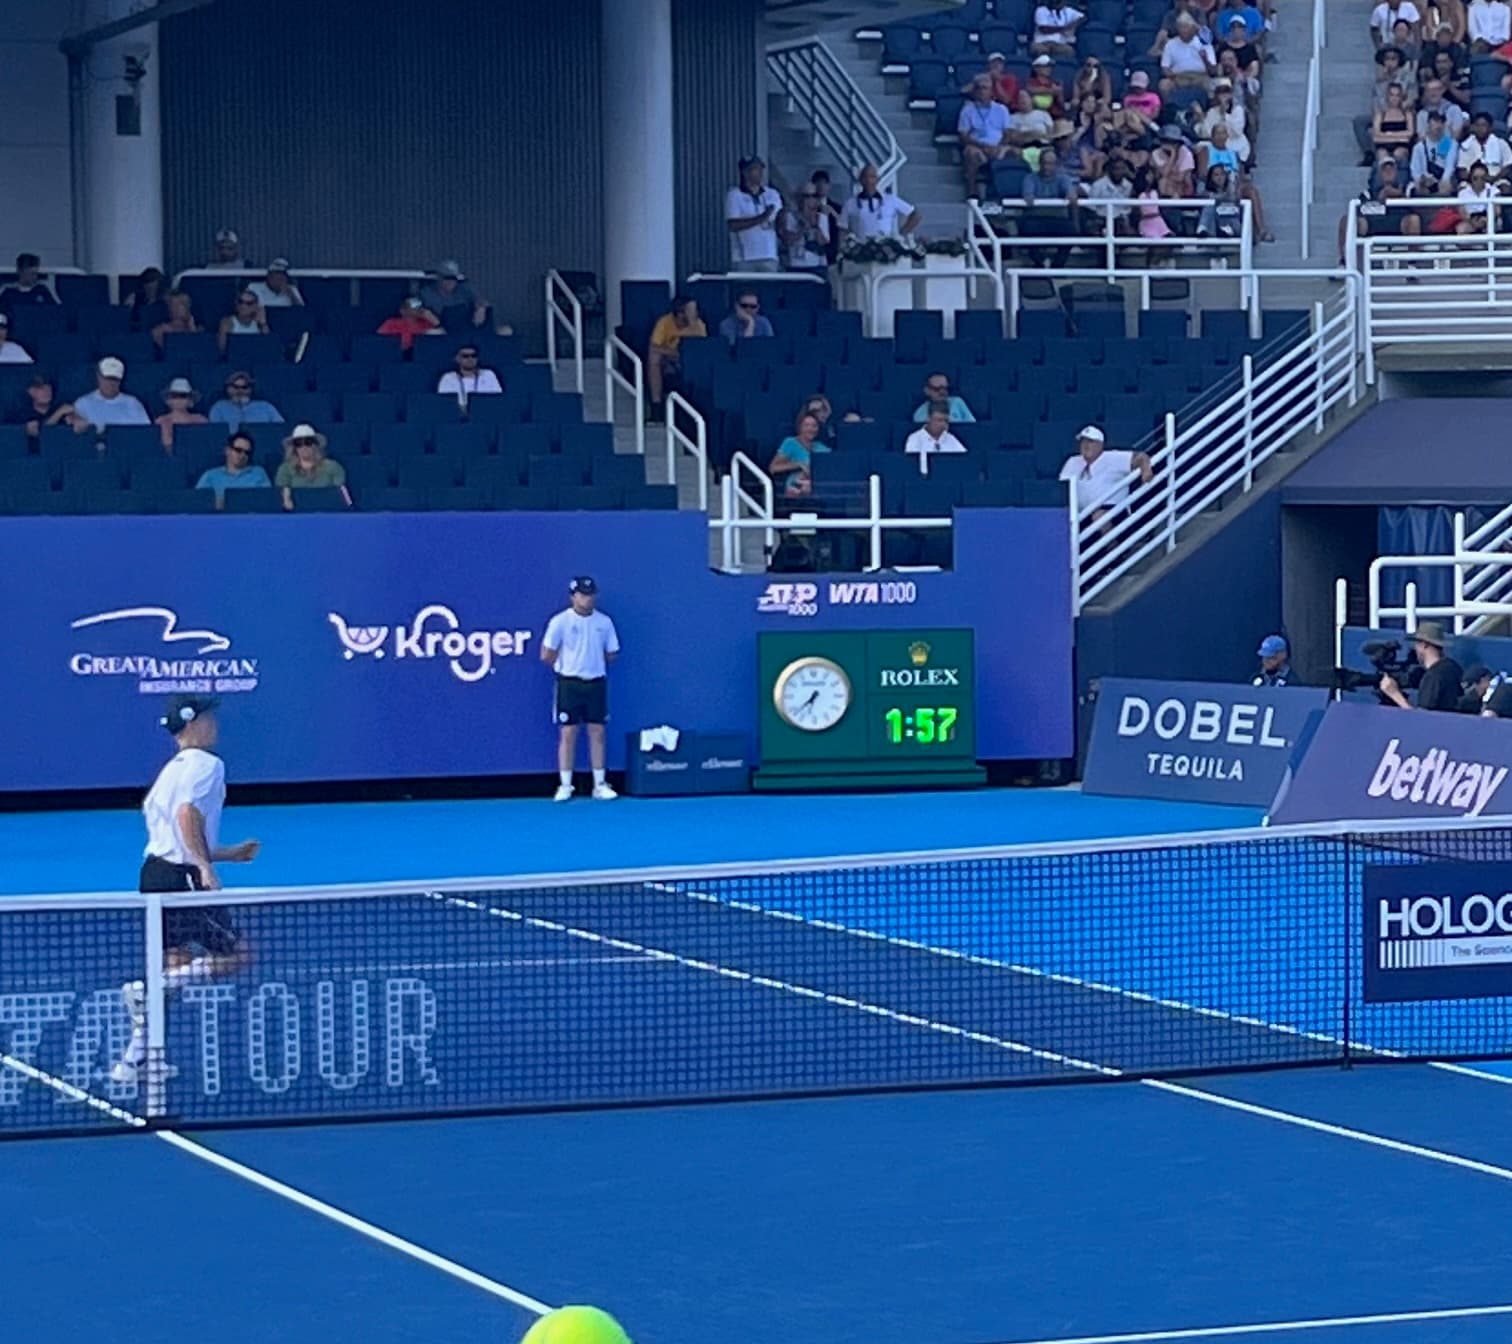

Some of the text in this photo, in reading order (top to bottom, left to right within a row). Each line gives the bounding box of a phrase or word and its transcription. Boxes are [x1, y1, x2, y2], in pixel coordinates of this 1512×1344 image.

[395, 604, 532, 682] Kroger
[880, 668, 960, 687] ROLEX
[884, 707, 958, 744] 1:57
[1117, 696, 1286, 748] DOBEL
[1147, 753, 1243, 781] TEQUILA
[1367, 738, 1508, 818] betway
[182, 978, 440, 1095] TOUR
